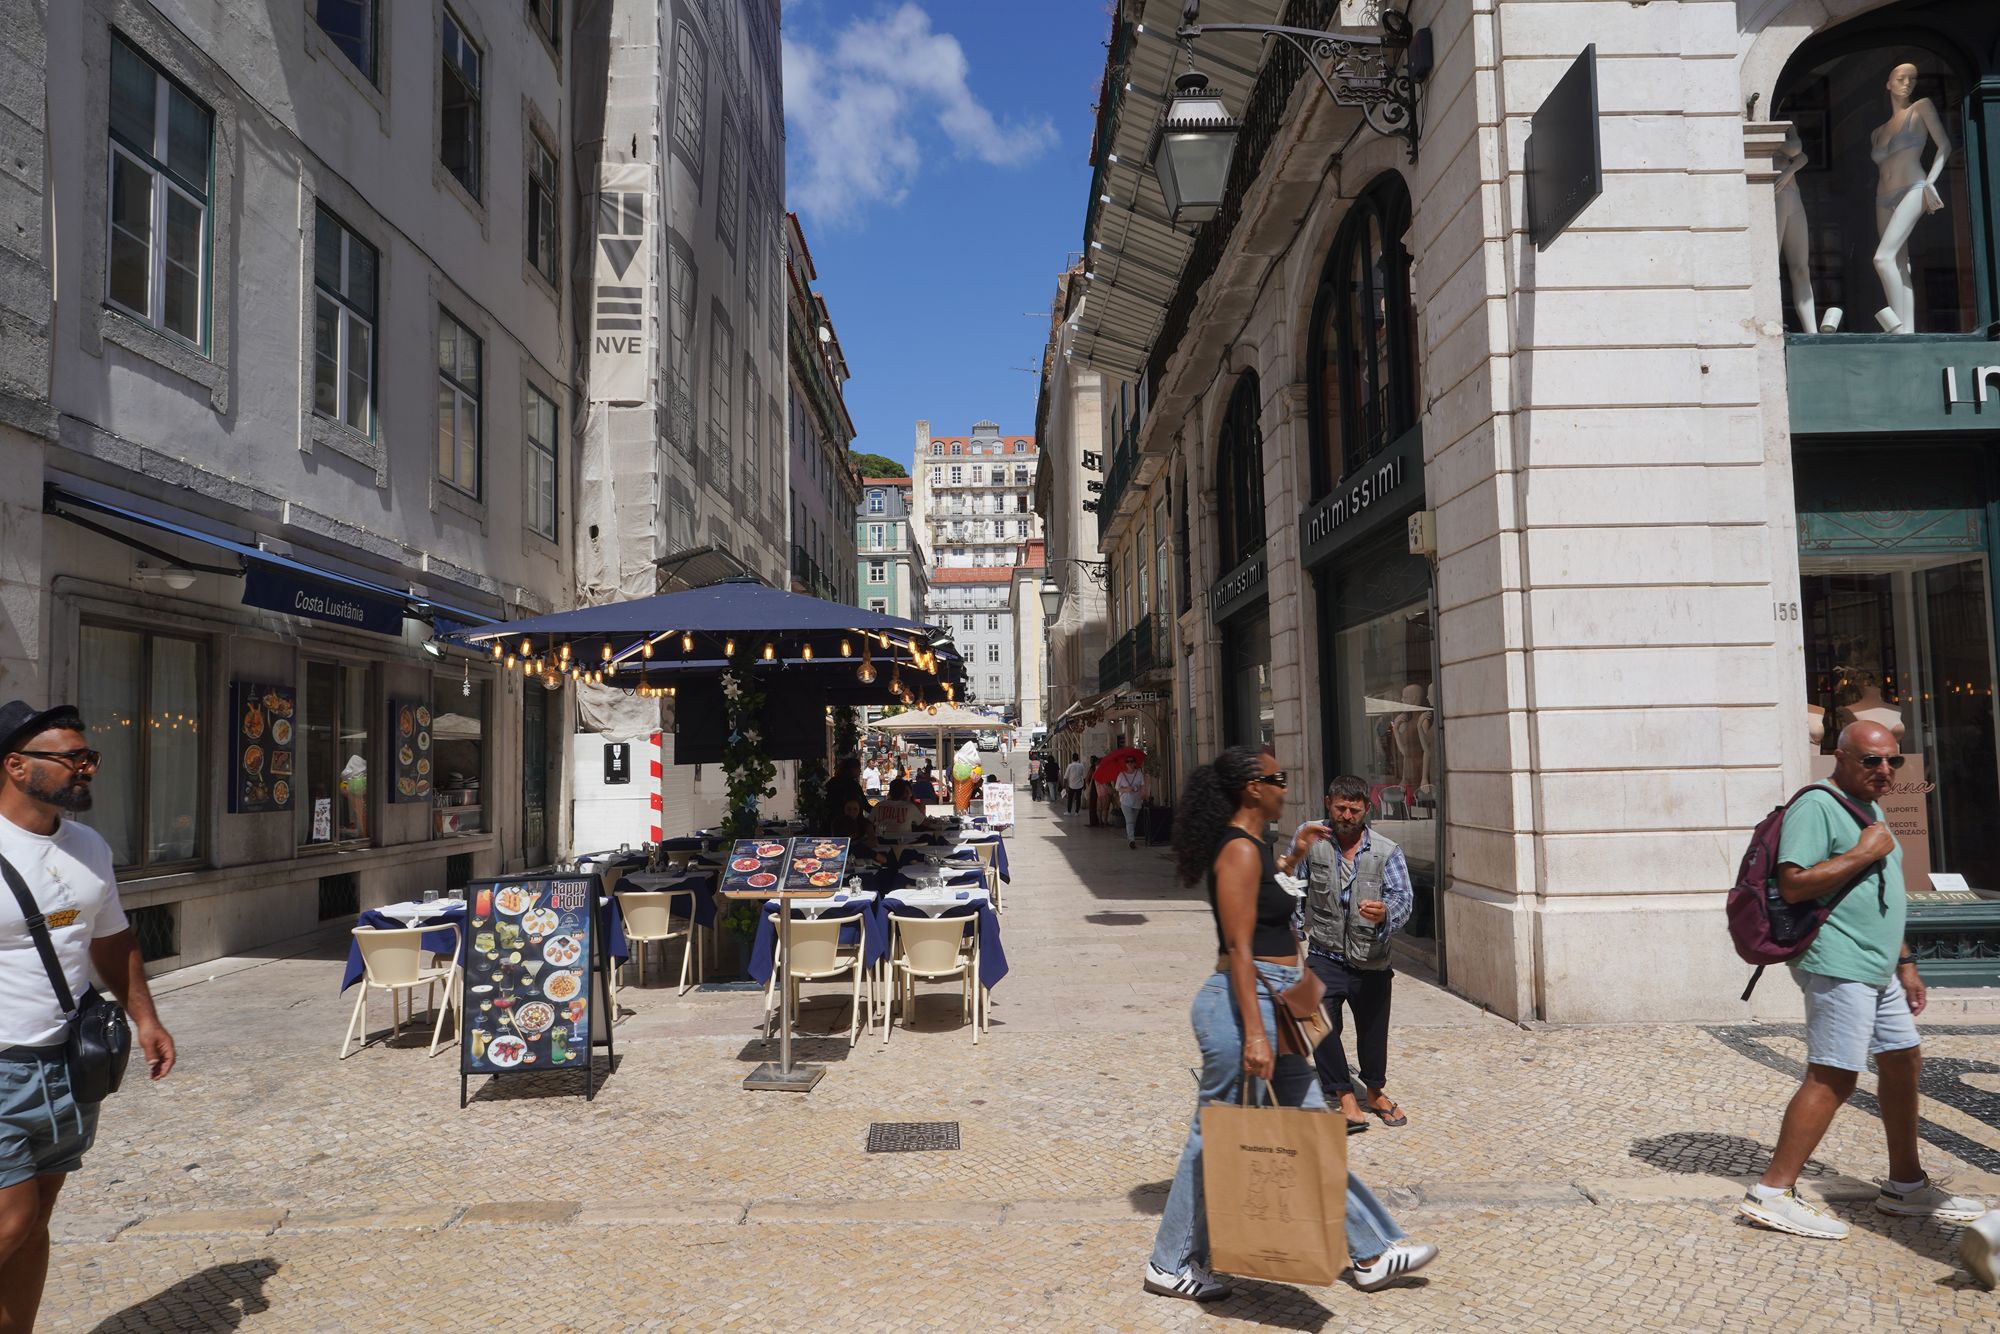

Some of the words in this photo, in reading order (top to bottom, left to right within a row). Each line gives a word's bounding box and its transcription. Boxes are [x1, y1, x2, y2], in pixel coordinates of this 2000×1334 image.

[596, 337, 641, 353] NVE
[1307, 455, 1402, 546] intimissimi
[1214, 561, 1262, 611] intimissimi
[295, 590, 324, 612] Costa
[325, 600, 364, 622] Lusitânia
[1773, 602, 1798, 621] 156
[1126, 691, 1160, 702] HOTEL
[1894, 828, 1927, 836] ORIZADO
[551, 881, 587, 896] Happy
[559, 894, 586, 912] Hour
[1240, 1144, 1273, 1153] Madeira
[1275, 1146, 1298, 1157] Shop
